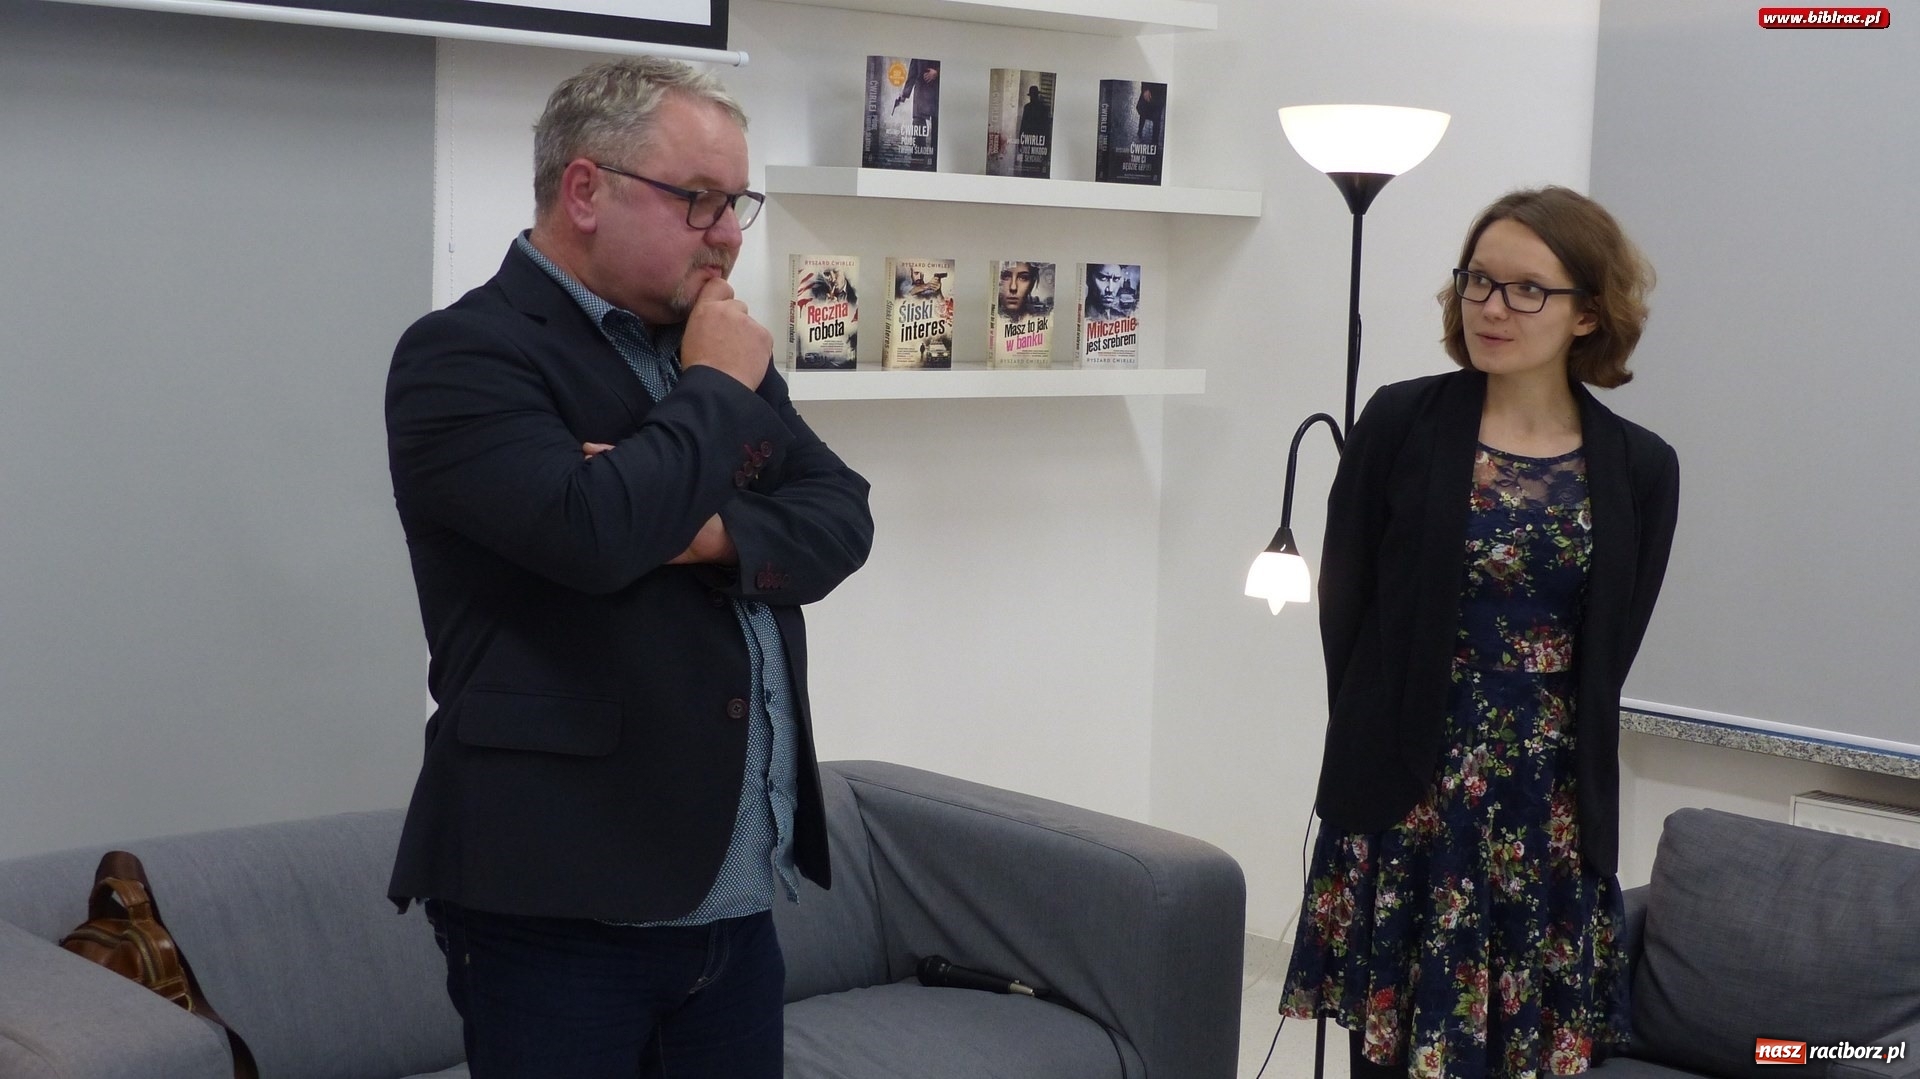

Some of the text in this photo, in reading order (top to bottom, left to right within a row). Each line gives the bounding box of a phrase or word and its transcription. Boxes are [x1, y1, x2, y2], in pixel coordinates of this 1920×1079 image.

[900, 124, 930, 137] ĆWIRLEJ
[1020, 132, 1046, 146] ĆWIRLEJ
[1130, 142, 1157, 155] ĆWIRLEJ
[808, 302, 848, 325] Ręczna
[898, 300, 933, 324] Śliski
[809, 320, 844, 342] robota
[900, 320, 946, 342] interes
[1004, 317, 1048, 338] Masz to jak
[1087, 316, 1138, 341] Milczenie
[1006, 332, 1043, 352] w banku
[1086, 338, 1102, 355] jest
[1102, 333, 1136, 350] srebrem
